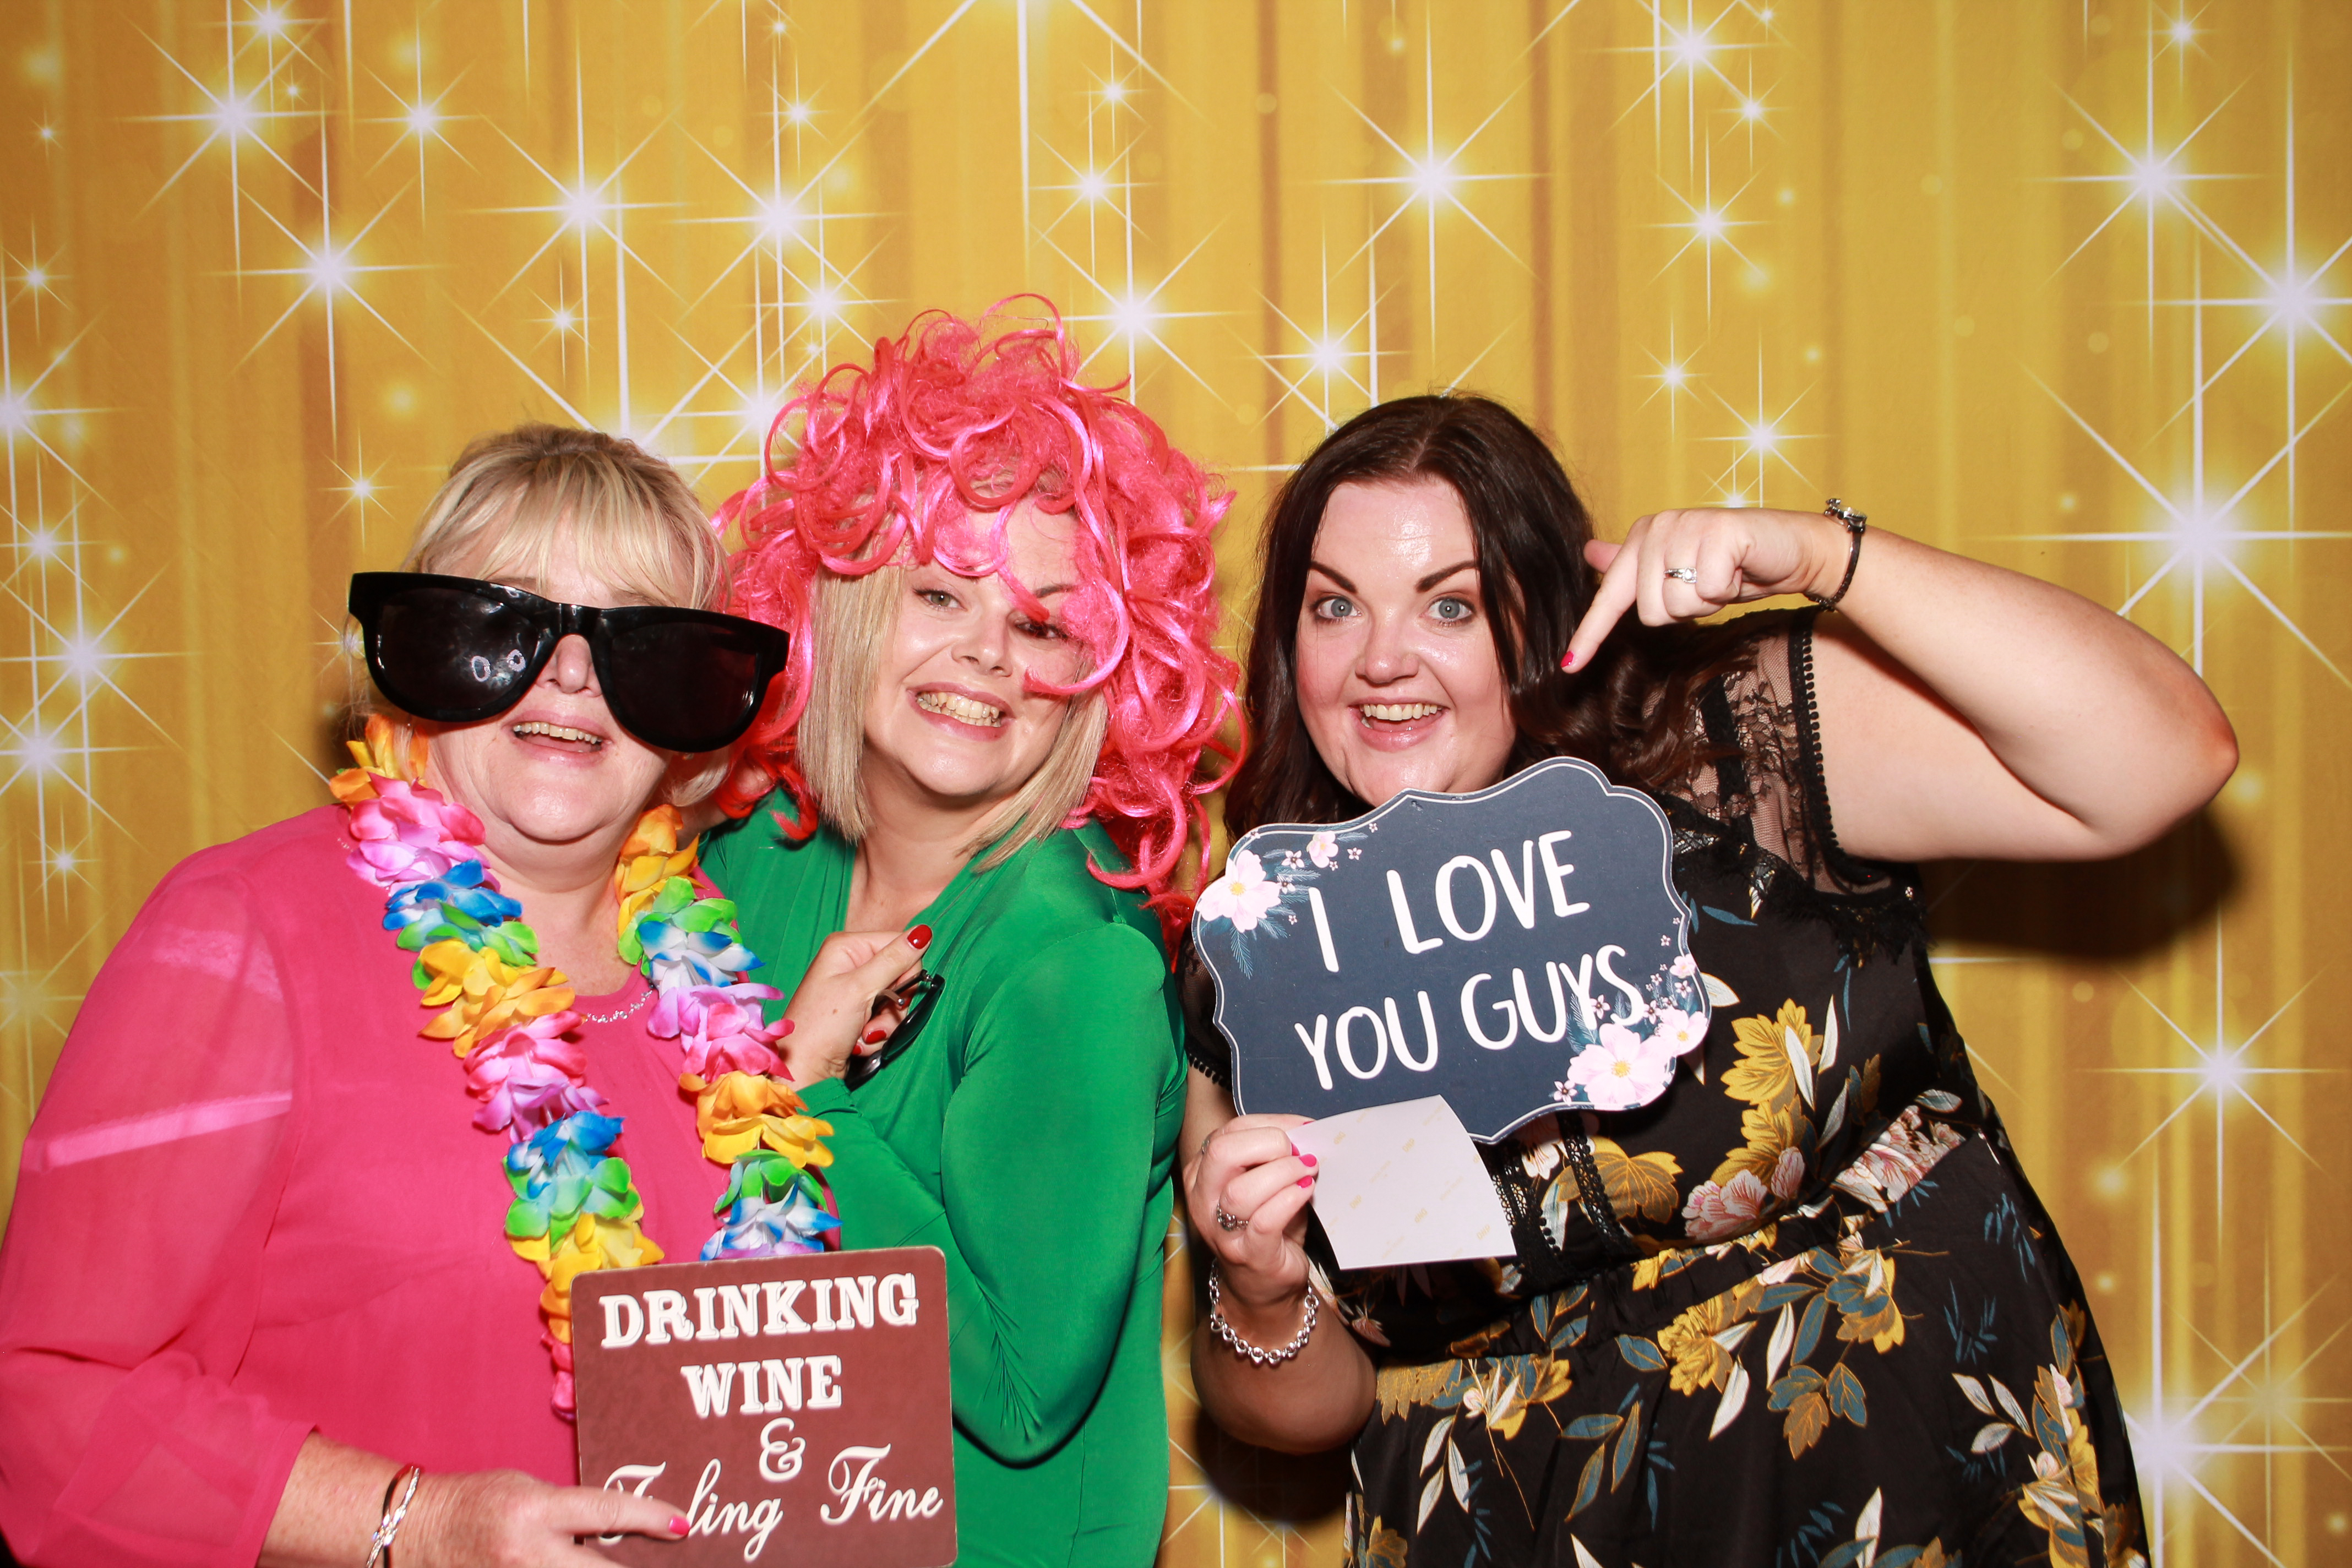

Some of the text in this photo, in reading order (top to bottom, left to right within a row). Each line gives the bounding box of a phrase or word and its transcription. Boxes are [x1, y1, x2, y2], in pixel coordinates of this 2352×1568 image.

[1308, 831, 1589, 972] I LOVE
[1295, 945, 1643, 1090] YOU GUYS
[599, 1273, 919, 1348] DRINKING
[680, 1355, 841, 1418] WINE
[759, 1418, 805, 1482] &
[598, 1444, 943, 1562] Fling Fine
